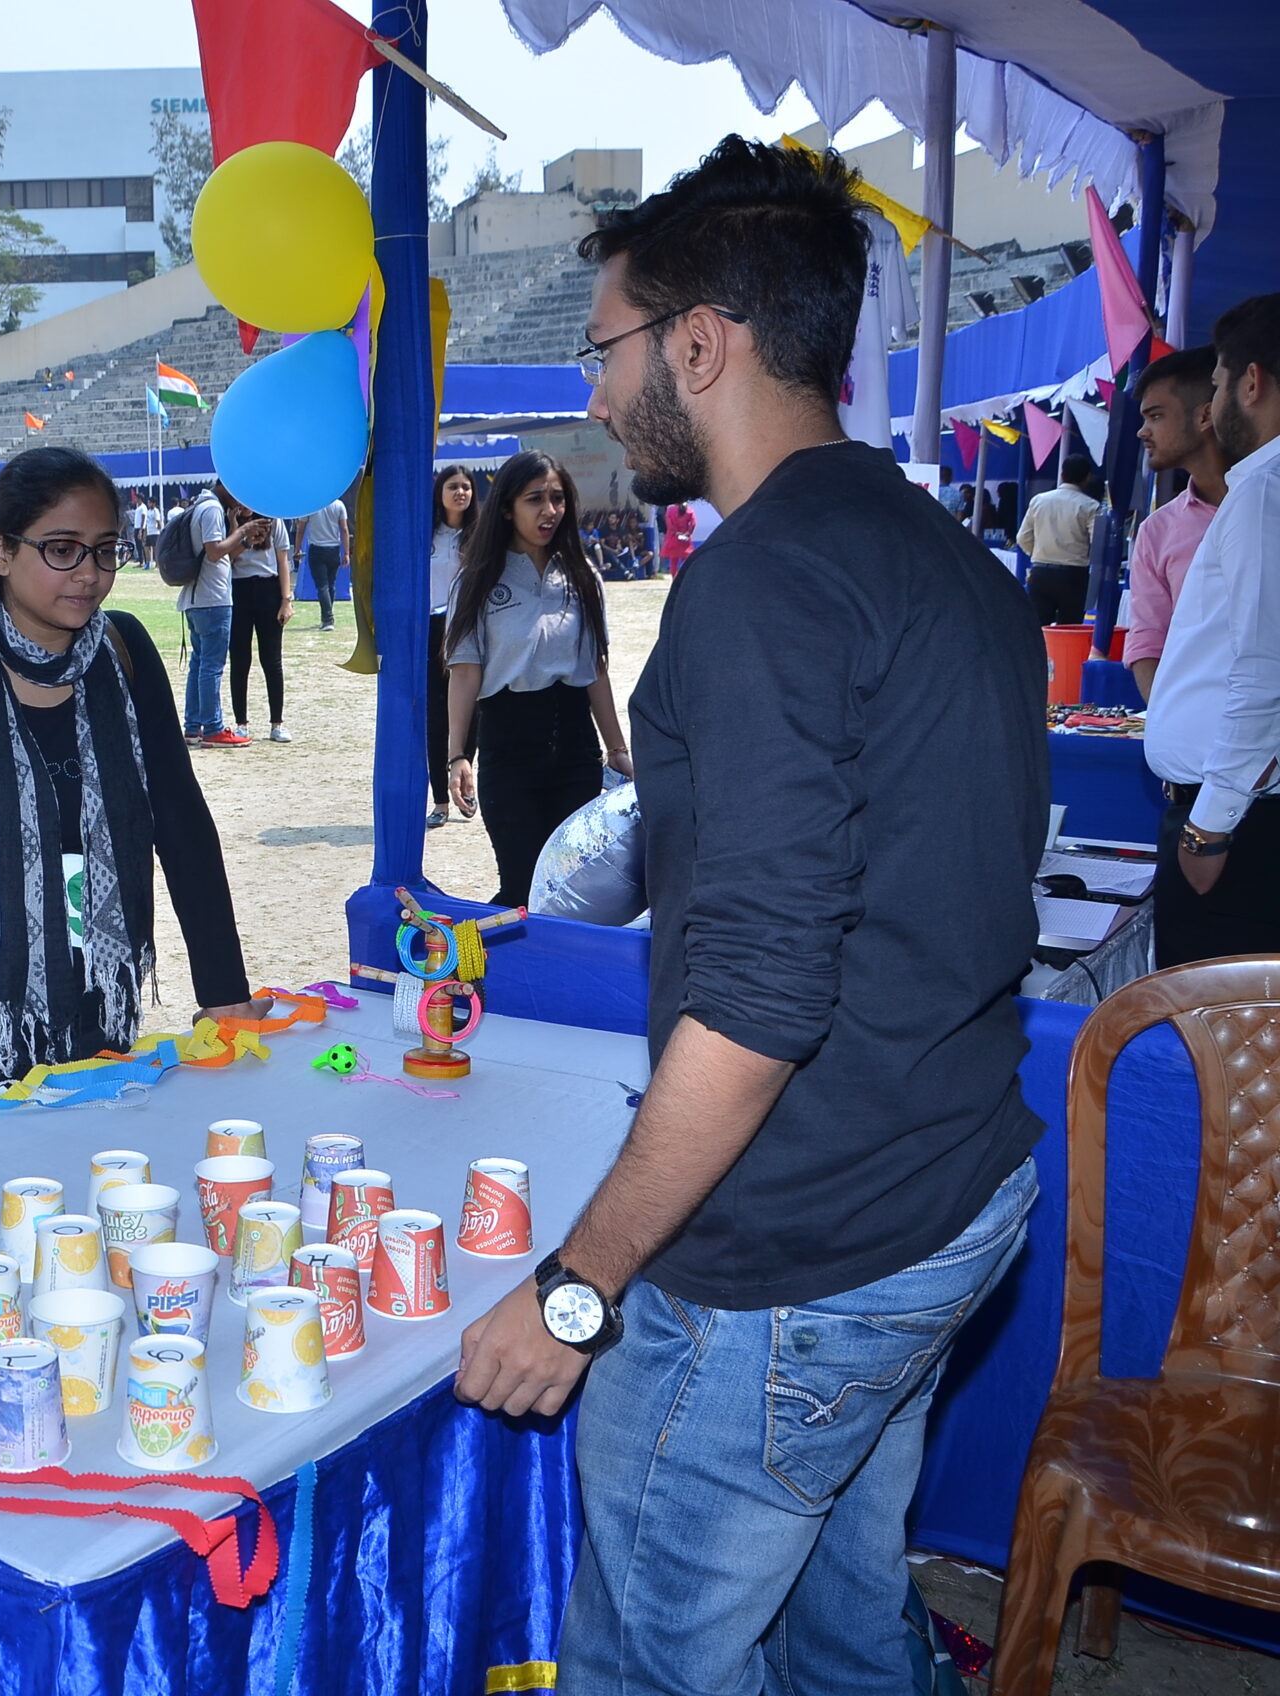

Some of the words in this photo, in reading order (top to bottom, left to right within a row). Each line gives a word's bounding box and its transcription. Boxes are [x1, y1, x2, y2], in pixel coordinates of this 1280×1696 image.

[313, 1154, 340, 1164] YOUR
[478, 1189, 503, 1208] Refresh
[475, 1229, 513, 1250] Happiness
[496, 1237, 516, 1251] Open
[385, 1244, 410, 1256] Refresh
[156, 1280, 191, 1296] diet
[147, 1289, 199, 1310] PIPSI
[129, 1405, 195, 1429] Smoothie
